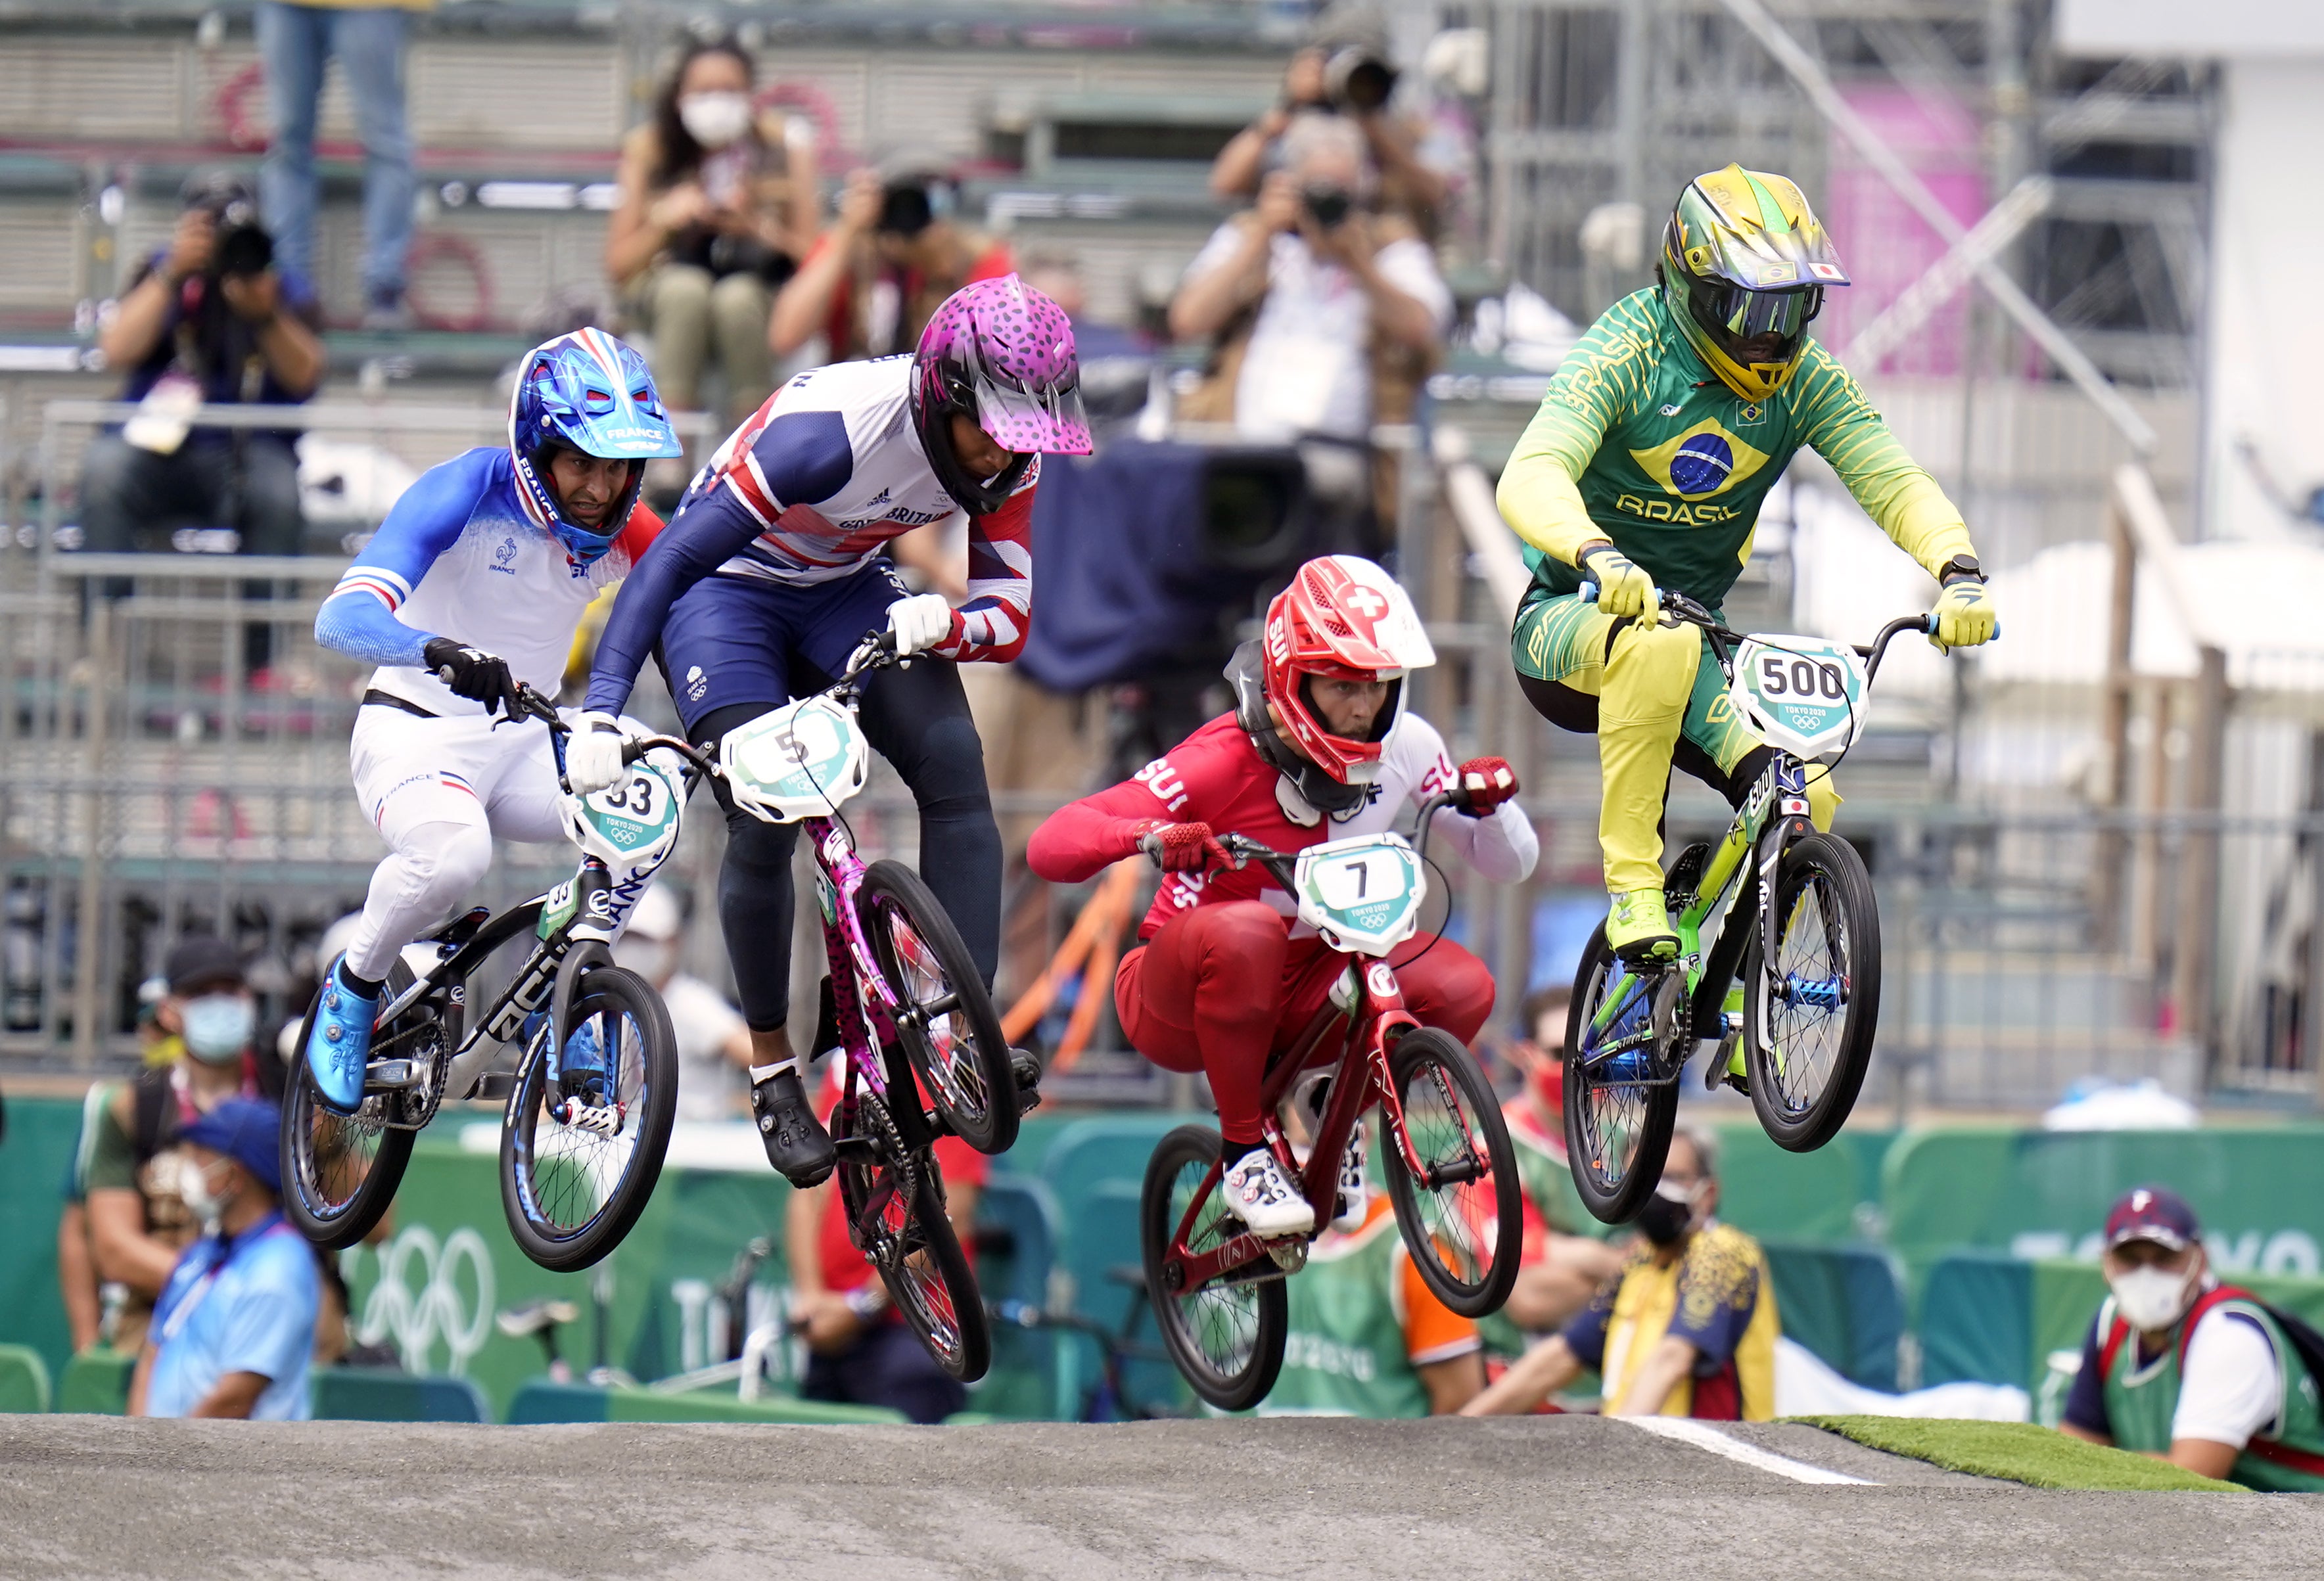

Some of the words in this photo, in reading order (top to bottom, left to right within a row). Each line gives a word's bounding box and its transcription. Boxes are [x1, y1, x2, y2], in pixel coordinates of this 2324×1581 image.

[606, 426, 664, 441] FRANCE
[519, 457, 559, 522] FRANCE
[866, 496, 893, 507] adidas
[1615, 493, 1742, 526] BRASIL
[488, 564, 516, 575] FRANCE
[1268, 615, 1288, 667] SUI
[1763, 658, 1843, 700] 500
[1784, 705, 1808, 715] TOKYO
[1809, 707, 1826, 717] 2020
[774, 730, 809, 764] 5
[385, 772, 434, 799] FRANCE
[785, 769, 809, 785] TOKY
[1134, 758, 1188, 813] SUI
[606, 817, 627, 829] TOKYO
[627, 822, 643, 833] 2020
[1345, 861, 1368, 899] 7
[1351, 905, 1373, 917] TOKYO
[1373, 902, 1391, 914] 2020
